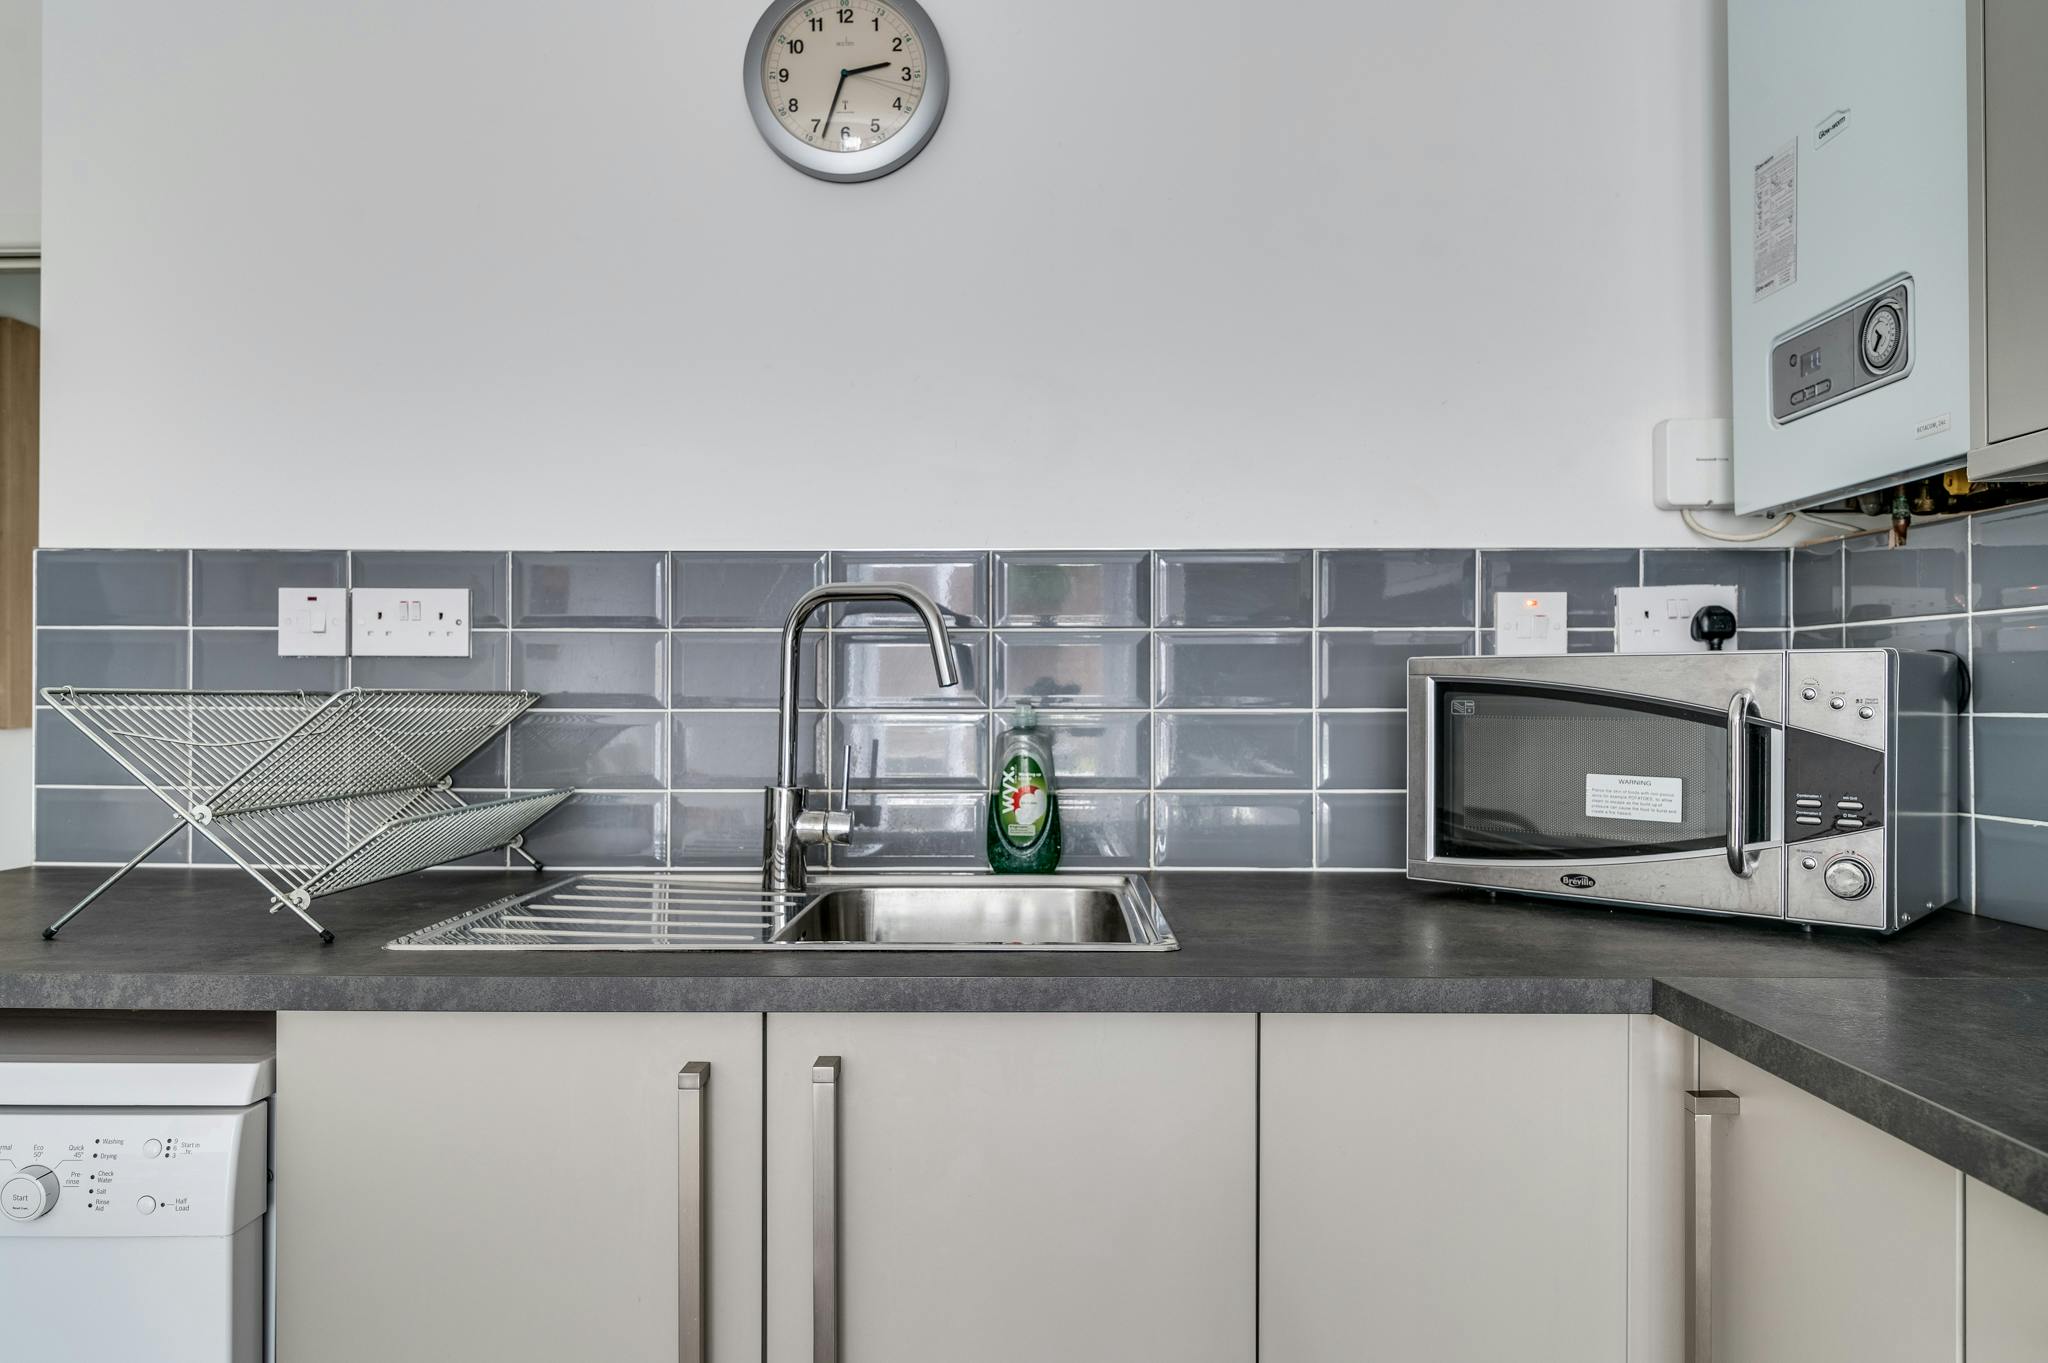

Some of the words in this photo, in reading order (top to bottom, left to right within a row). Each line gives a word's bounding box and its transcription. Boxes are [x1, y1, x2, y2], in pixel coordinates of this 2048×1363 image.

[836, 8, 854, 24] 12
[809, 18, 823, 32] 11
[872, 18, 879, 32] 1
[787, 40, 804, 54] 10
[892, 38, 902, 52] 2
[778, 68, 789, 82] 9
[902, 68, 912, 81] 3
[788, 98, 798, 112] 8
[892, 97, 902, 110] 4
[811, 119, 821, 133] 7
[870, 119, 880, 132] 5
[840, 126, 850, 140] 6
